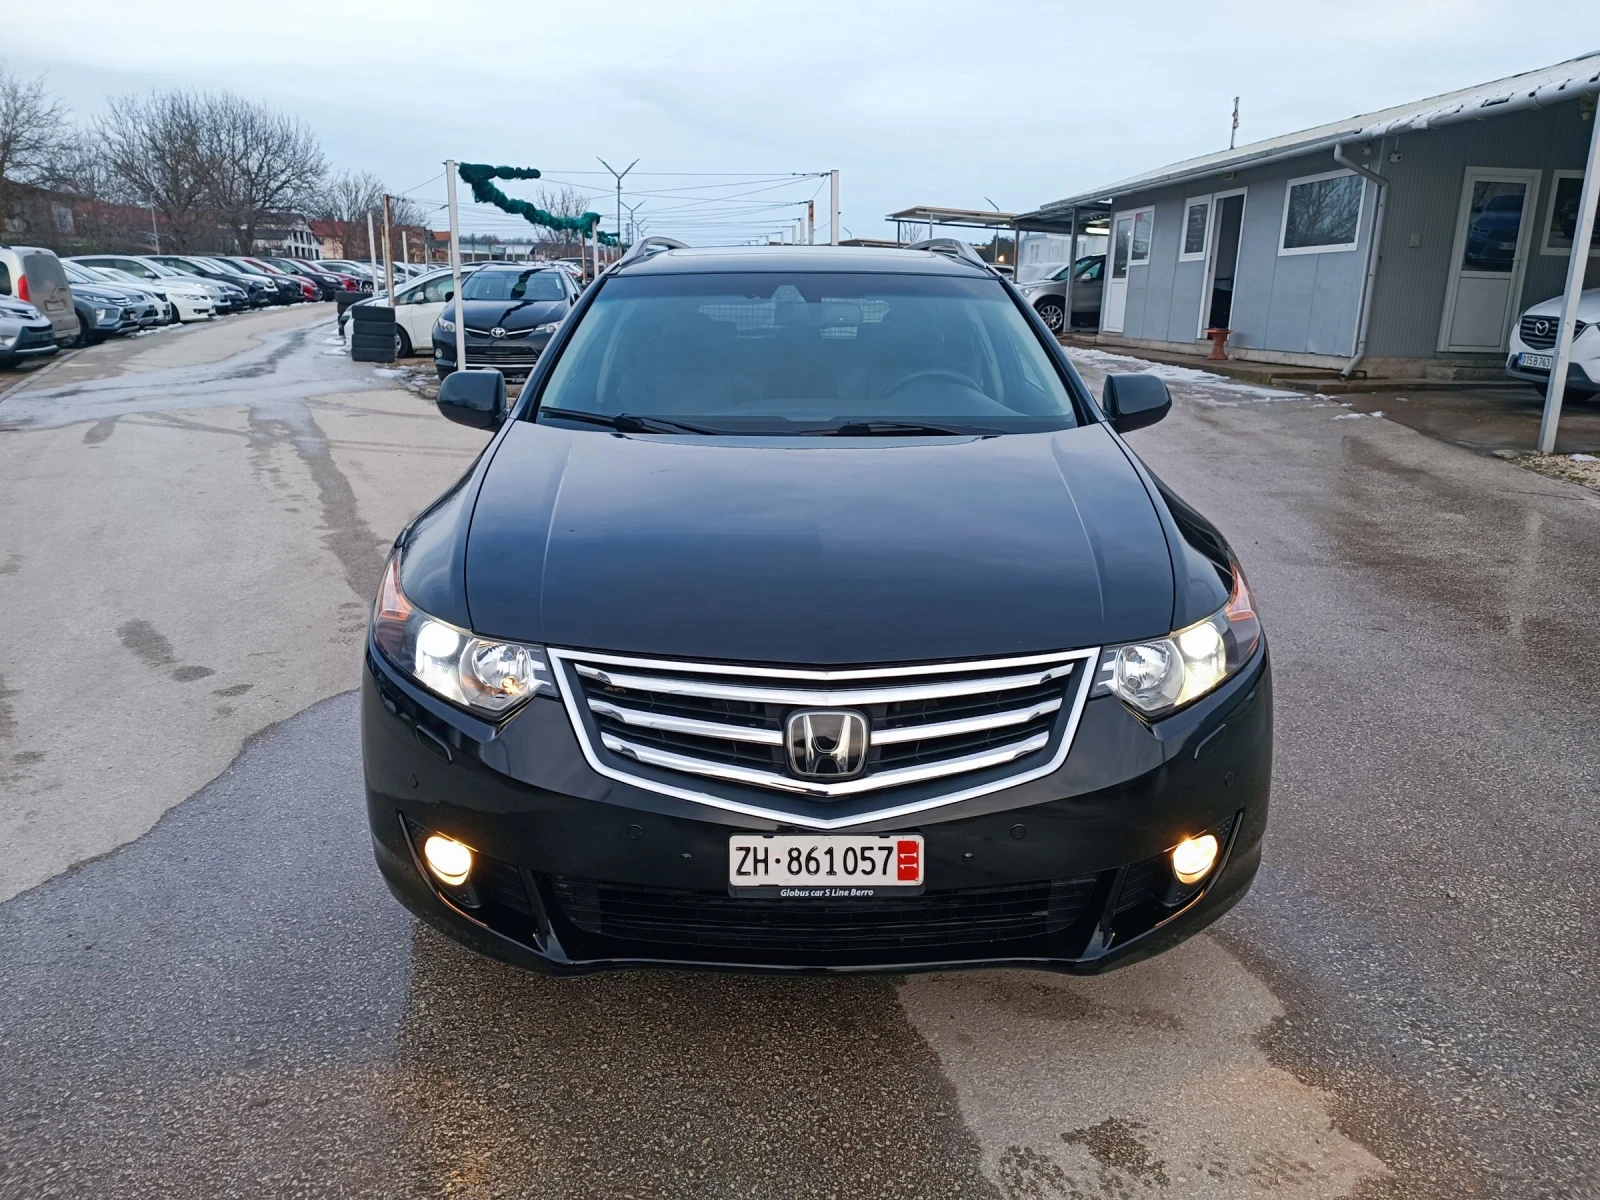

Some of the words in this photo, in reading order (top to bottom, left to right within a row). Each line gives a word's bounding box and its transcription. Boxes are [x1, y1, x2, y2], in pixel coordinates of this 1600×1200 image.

[780, 889, 809, 897] Globus
[825, 889, 830, 897] S
[832, 888, 849, 897] Line
[850, 888, 874, 896] Berro
